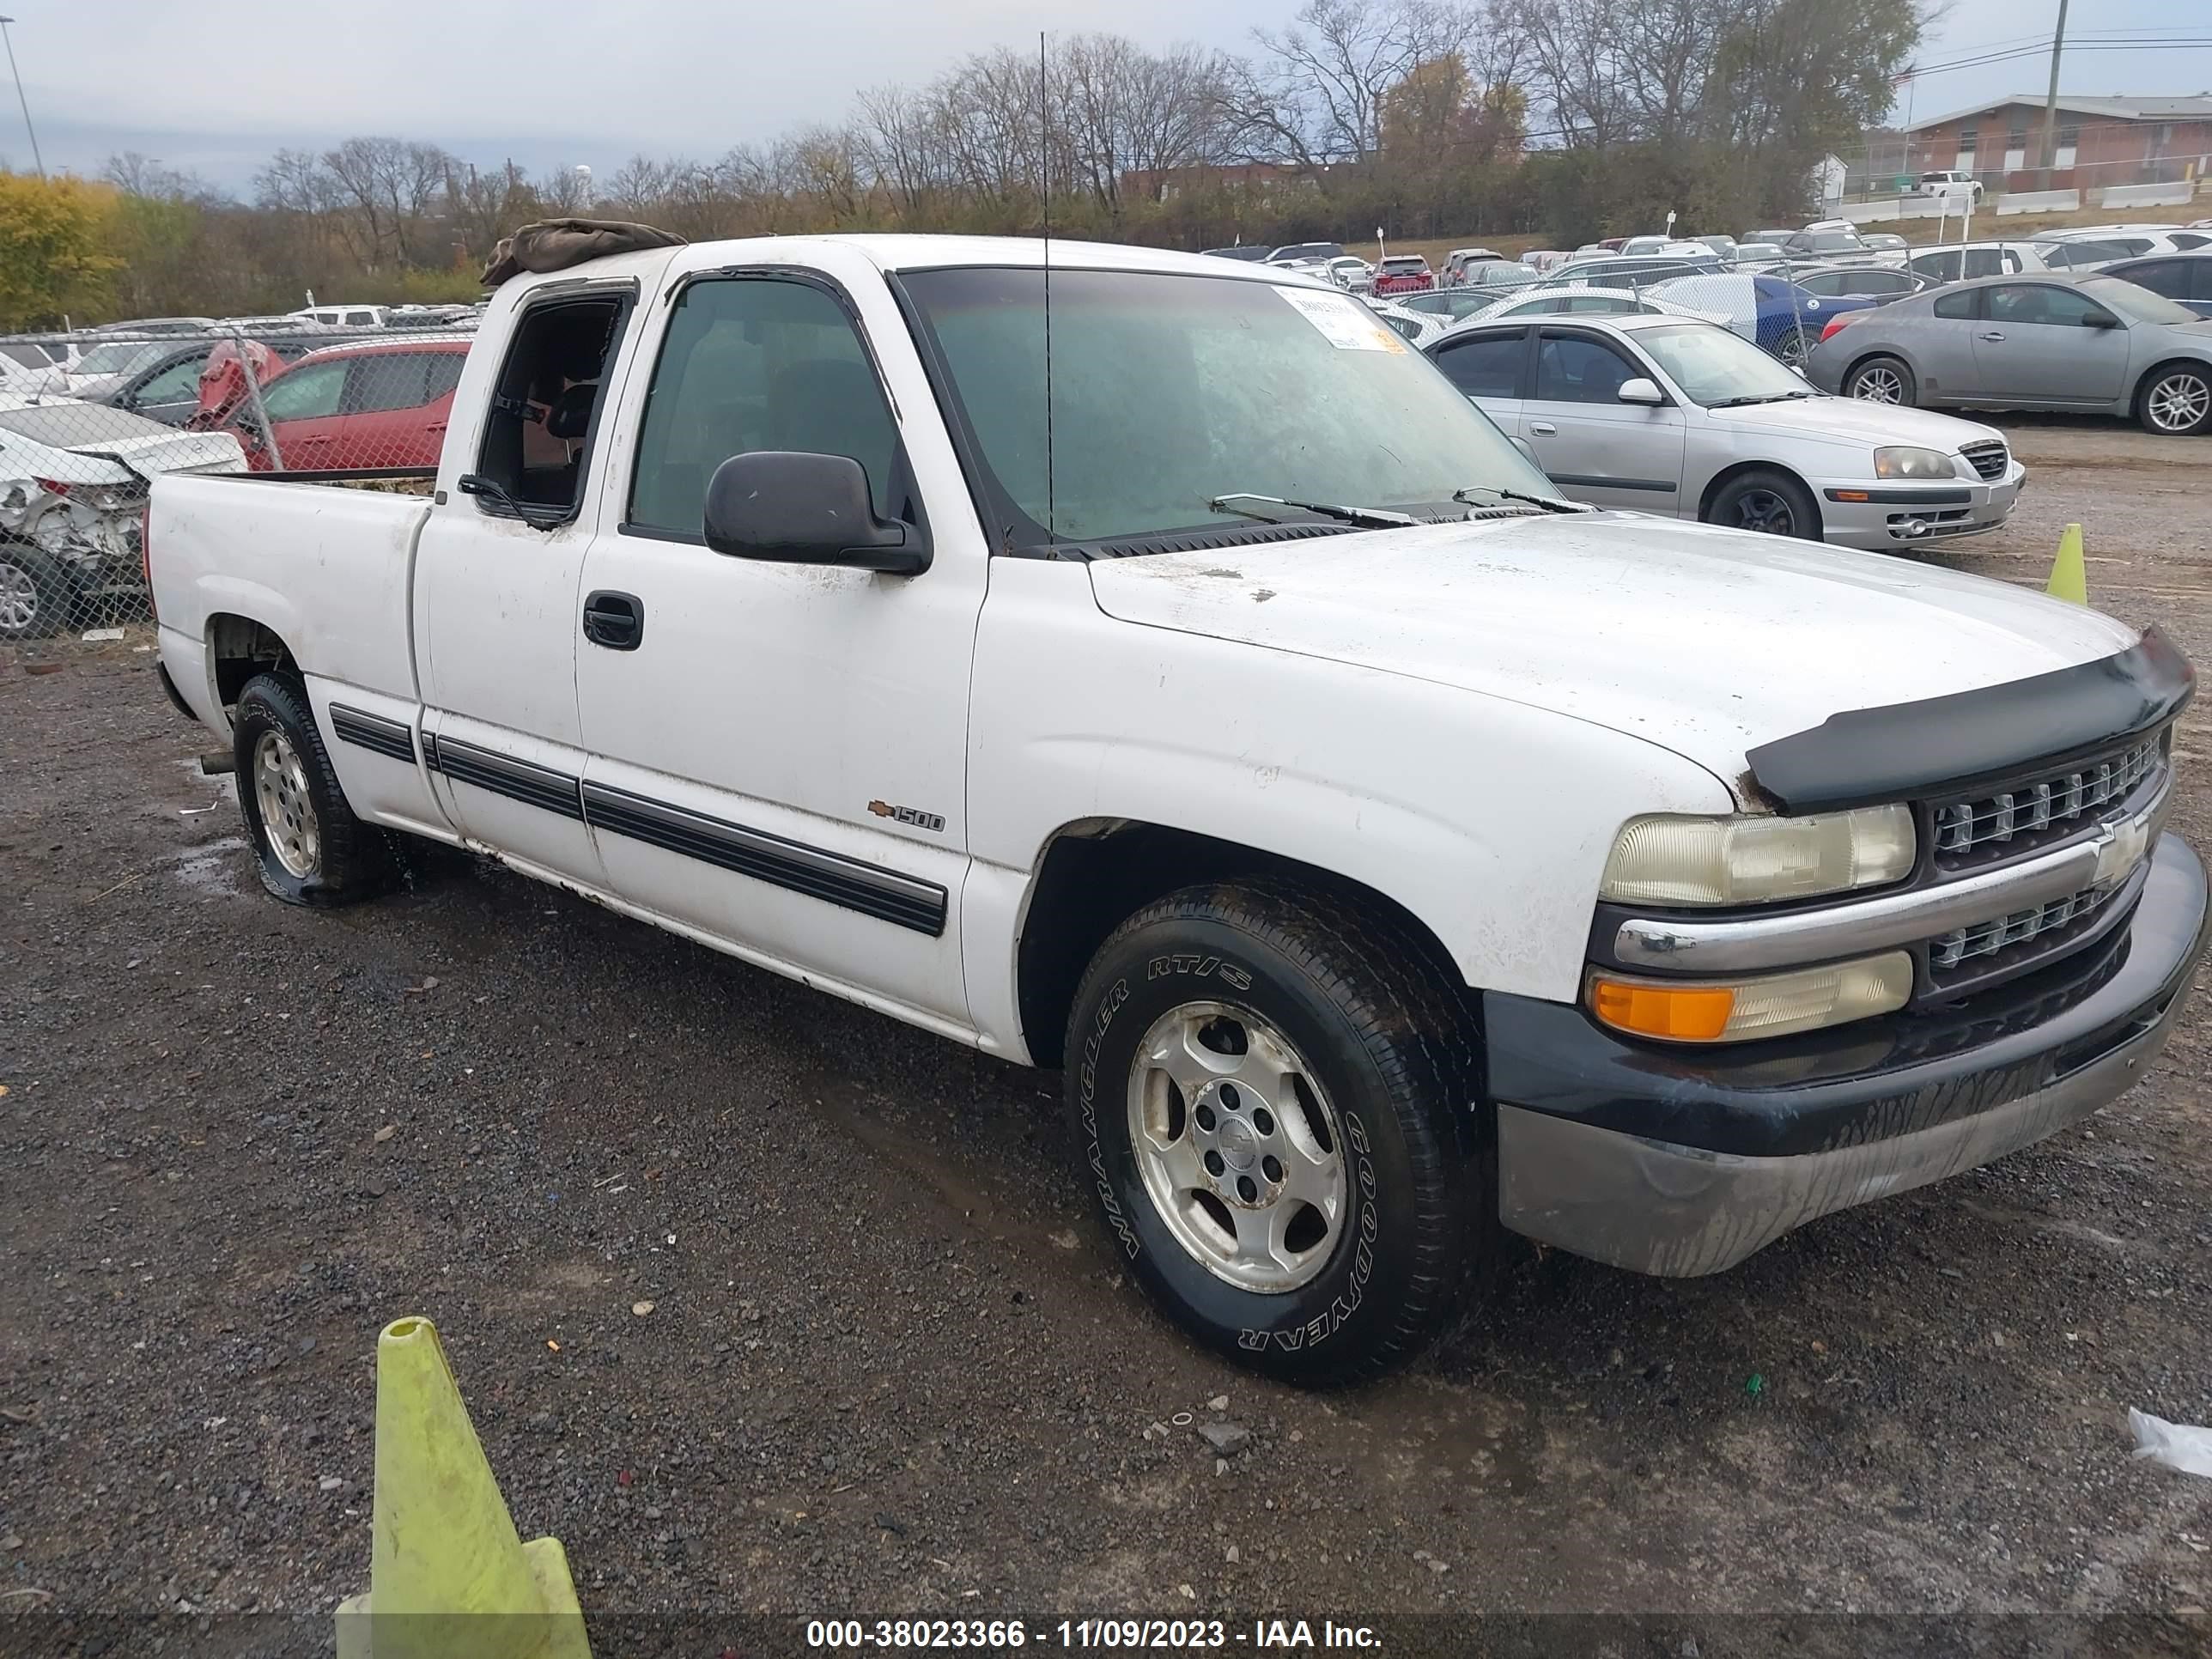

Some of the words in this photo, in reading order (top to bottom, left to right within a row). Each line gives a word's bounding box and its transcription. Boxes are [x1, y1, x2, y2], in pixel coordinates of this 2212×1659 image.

[893, 805, 946, 832] 1500
[1080, 978, 1140, 1260] WRANGLER
[1148, 955, 1253, 991] RT/S
[1237, 1110, 1378, 1352] GOODYEAR
